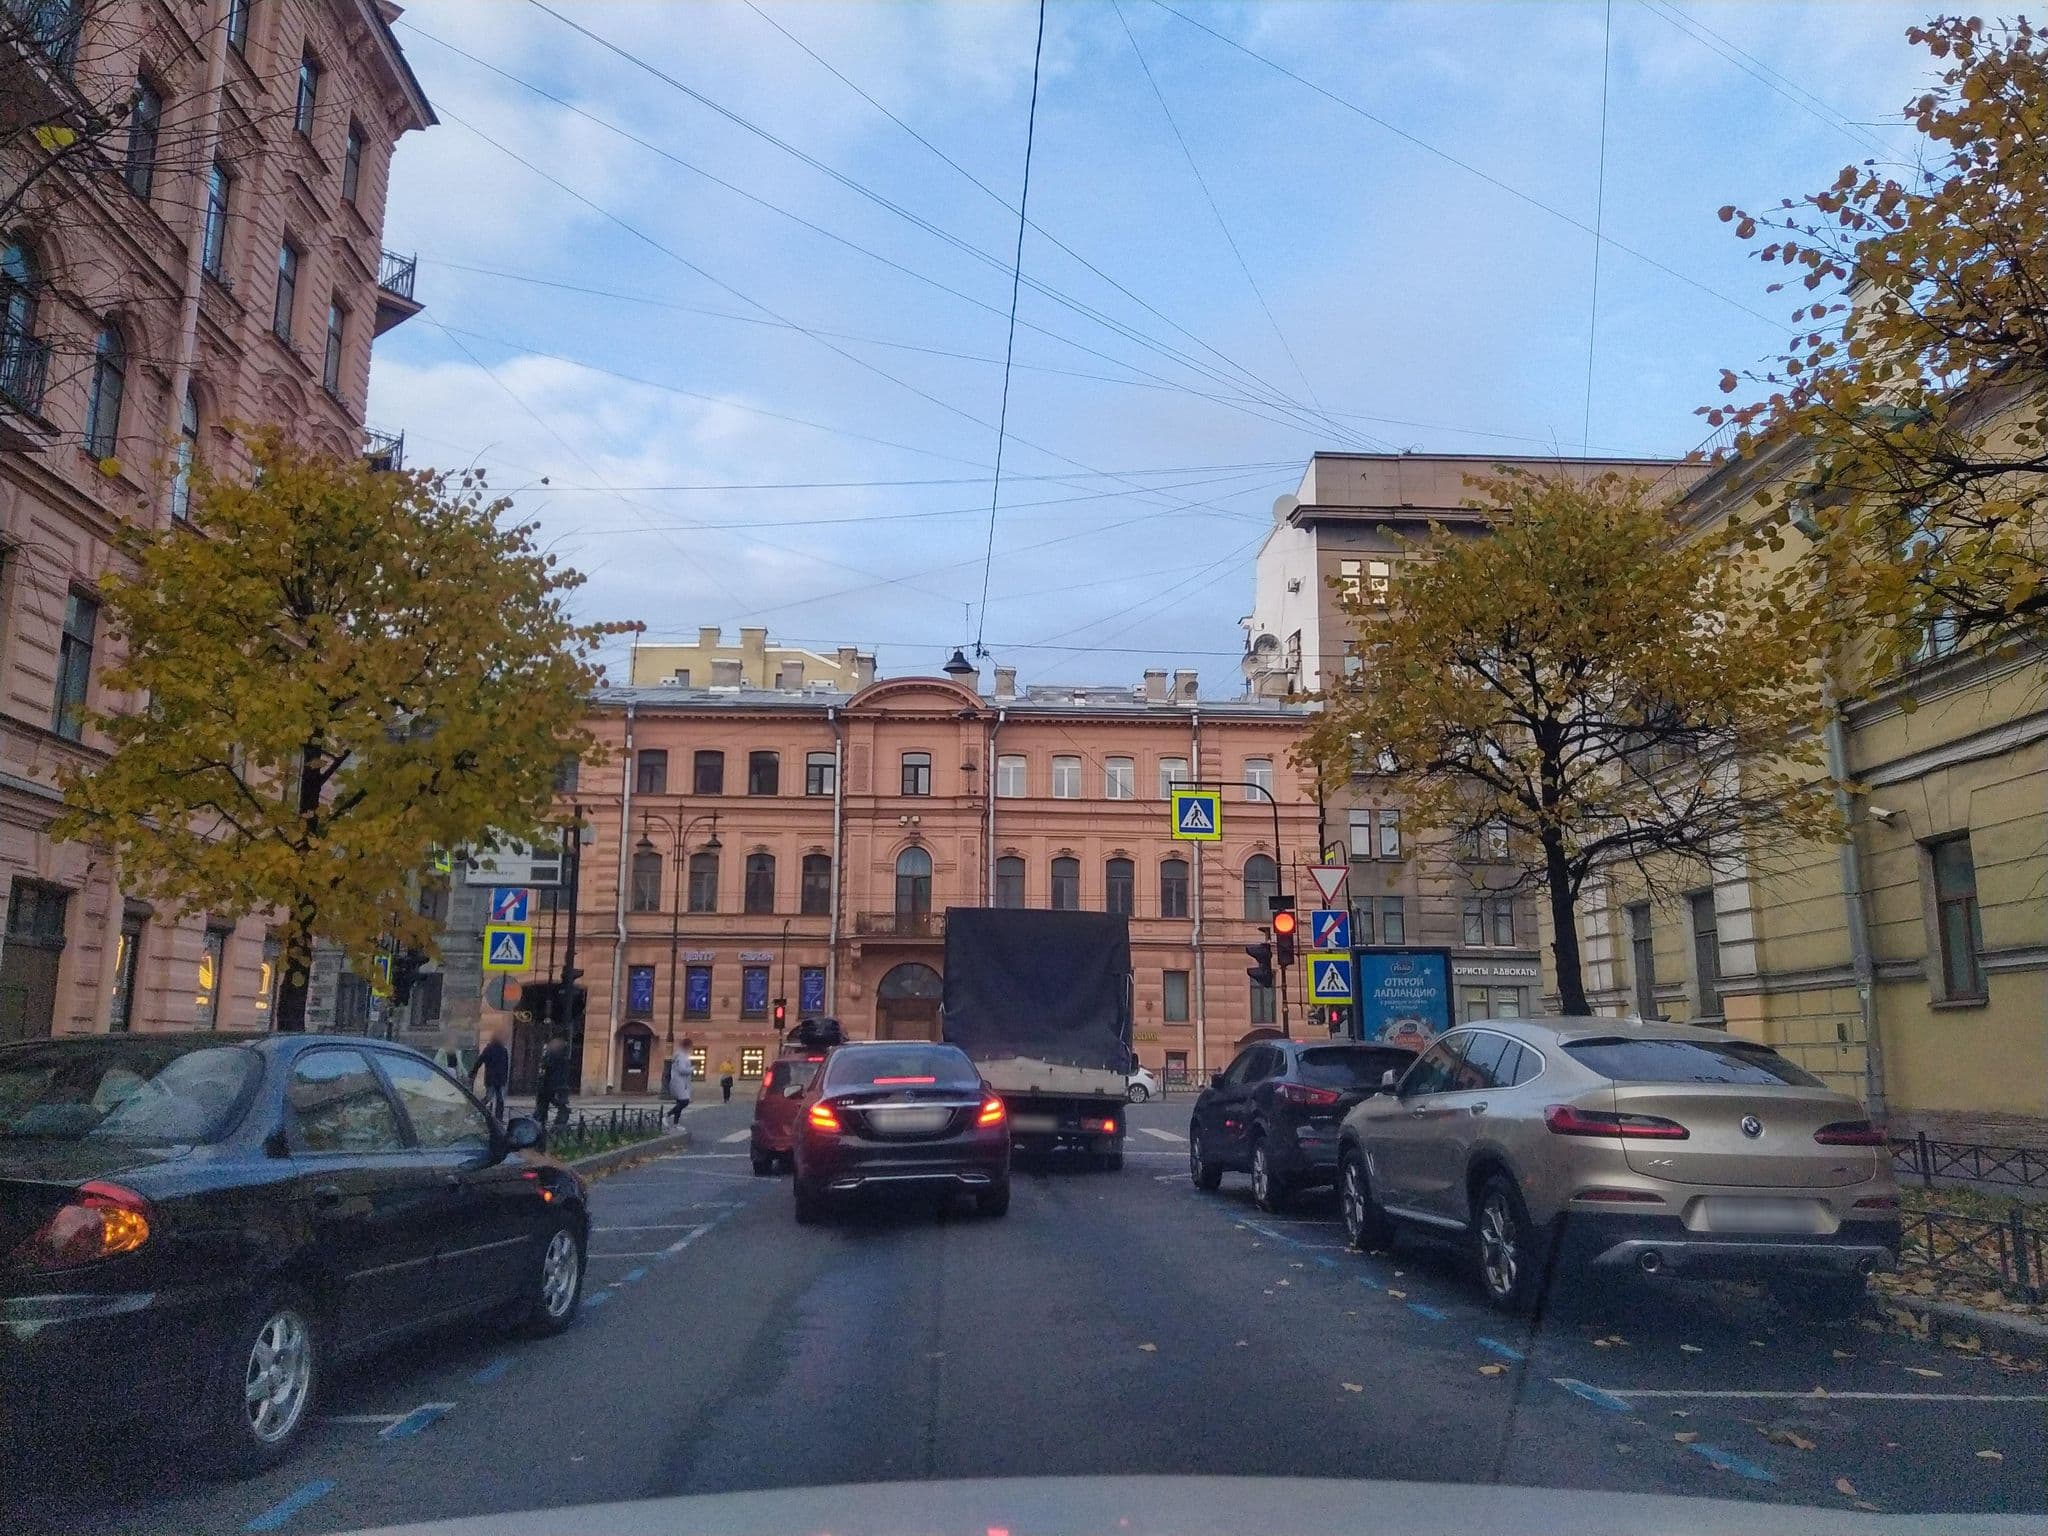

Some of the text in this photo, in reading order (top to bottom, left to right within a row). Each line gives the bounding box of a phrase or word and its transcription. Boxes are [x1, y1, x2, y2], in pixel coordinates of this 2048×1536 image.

[1453, 967, 1537, 977] ЮРИСТЫ АДВОКАТЫ
[1384, 977, 1425, 987] ОТКРОЙ
[1373, 988, 1437, 998] ЛАПЛАНДИЮ
